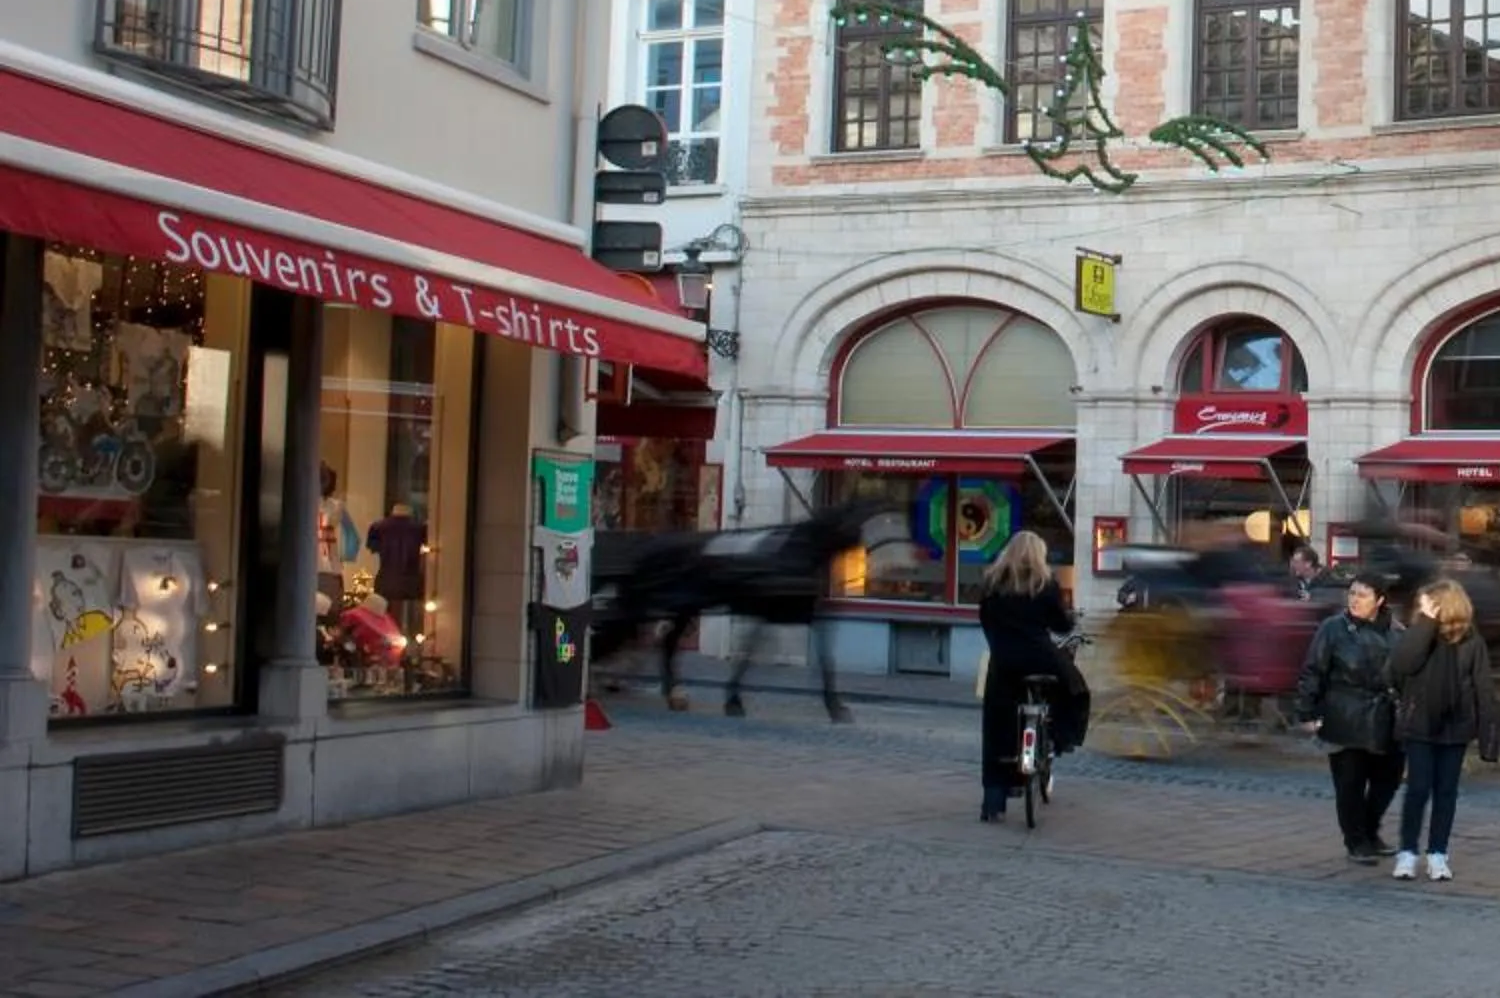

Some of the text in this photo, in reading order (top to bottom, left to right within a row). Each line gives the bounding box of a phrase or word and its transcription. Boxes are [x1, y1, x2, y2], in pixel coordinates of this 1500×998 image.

[157, 212, 600, 356] Souvenirs & T-shirts
[1457, 467, 1493, 477] HOTEL
